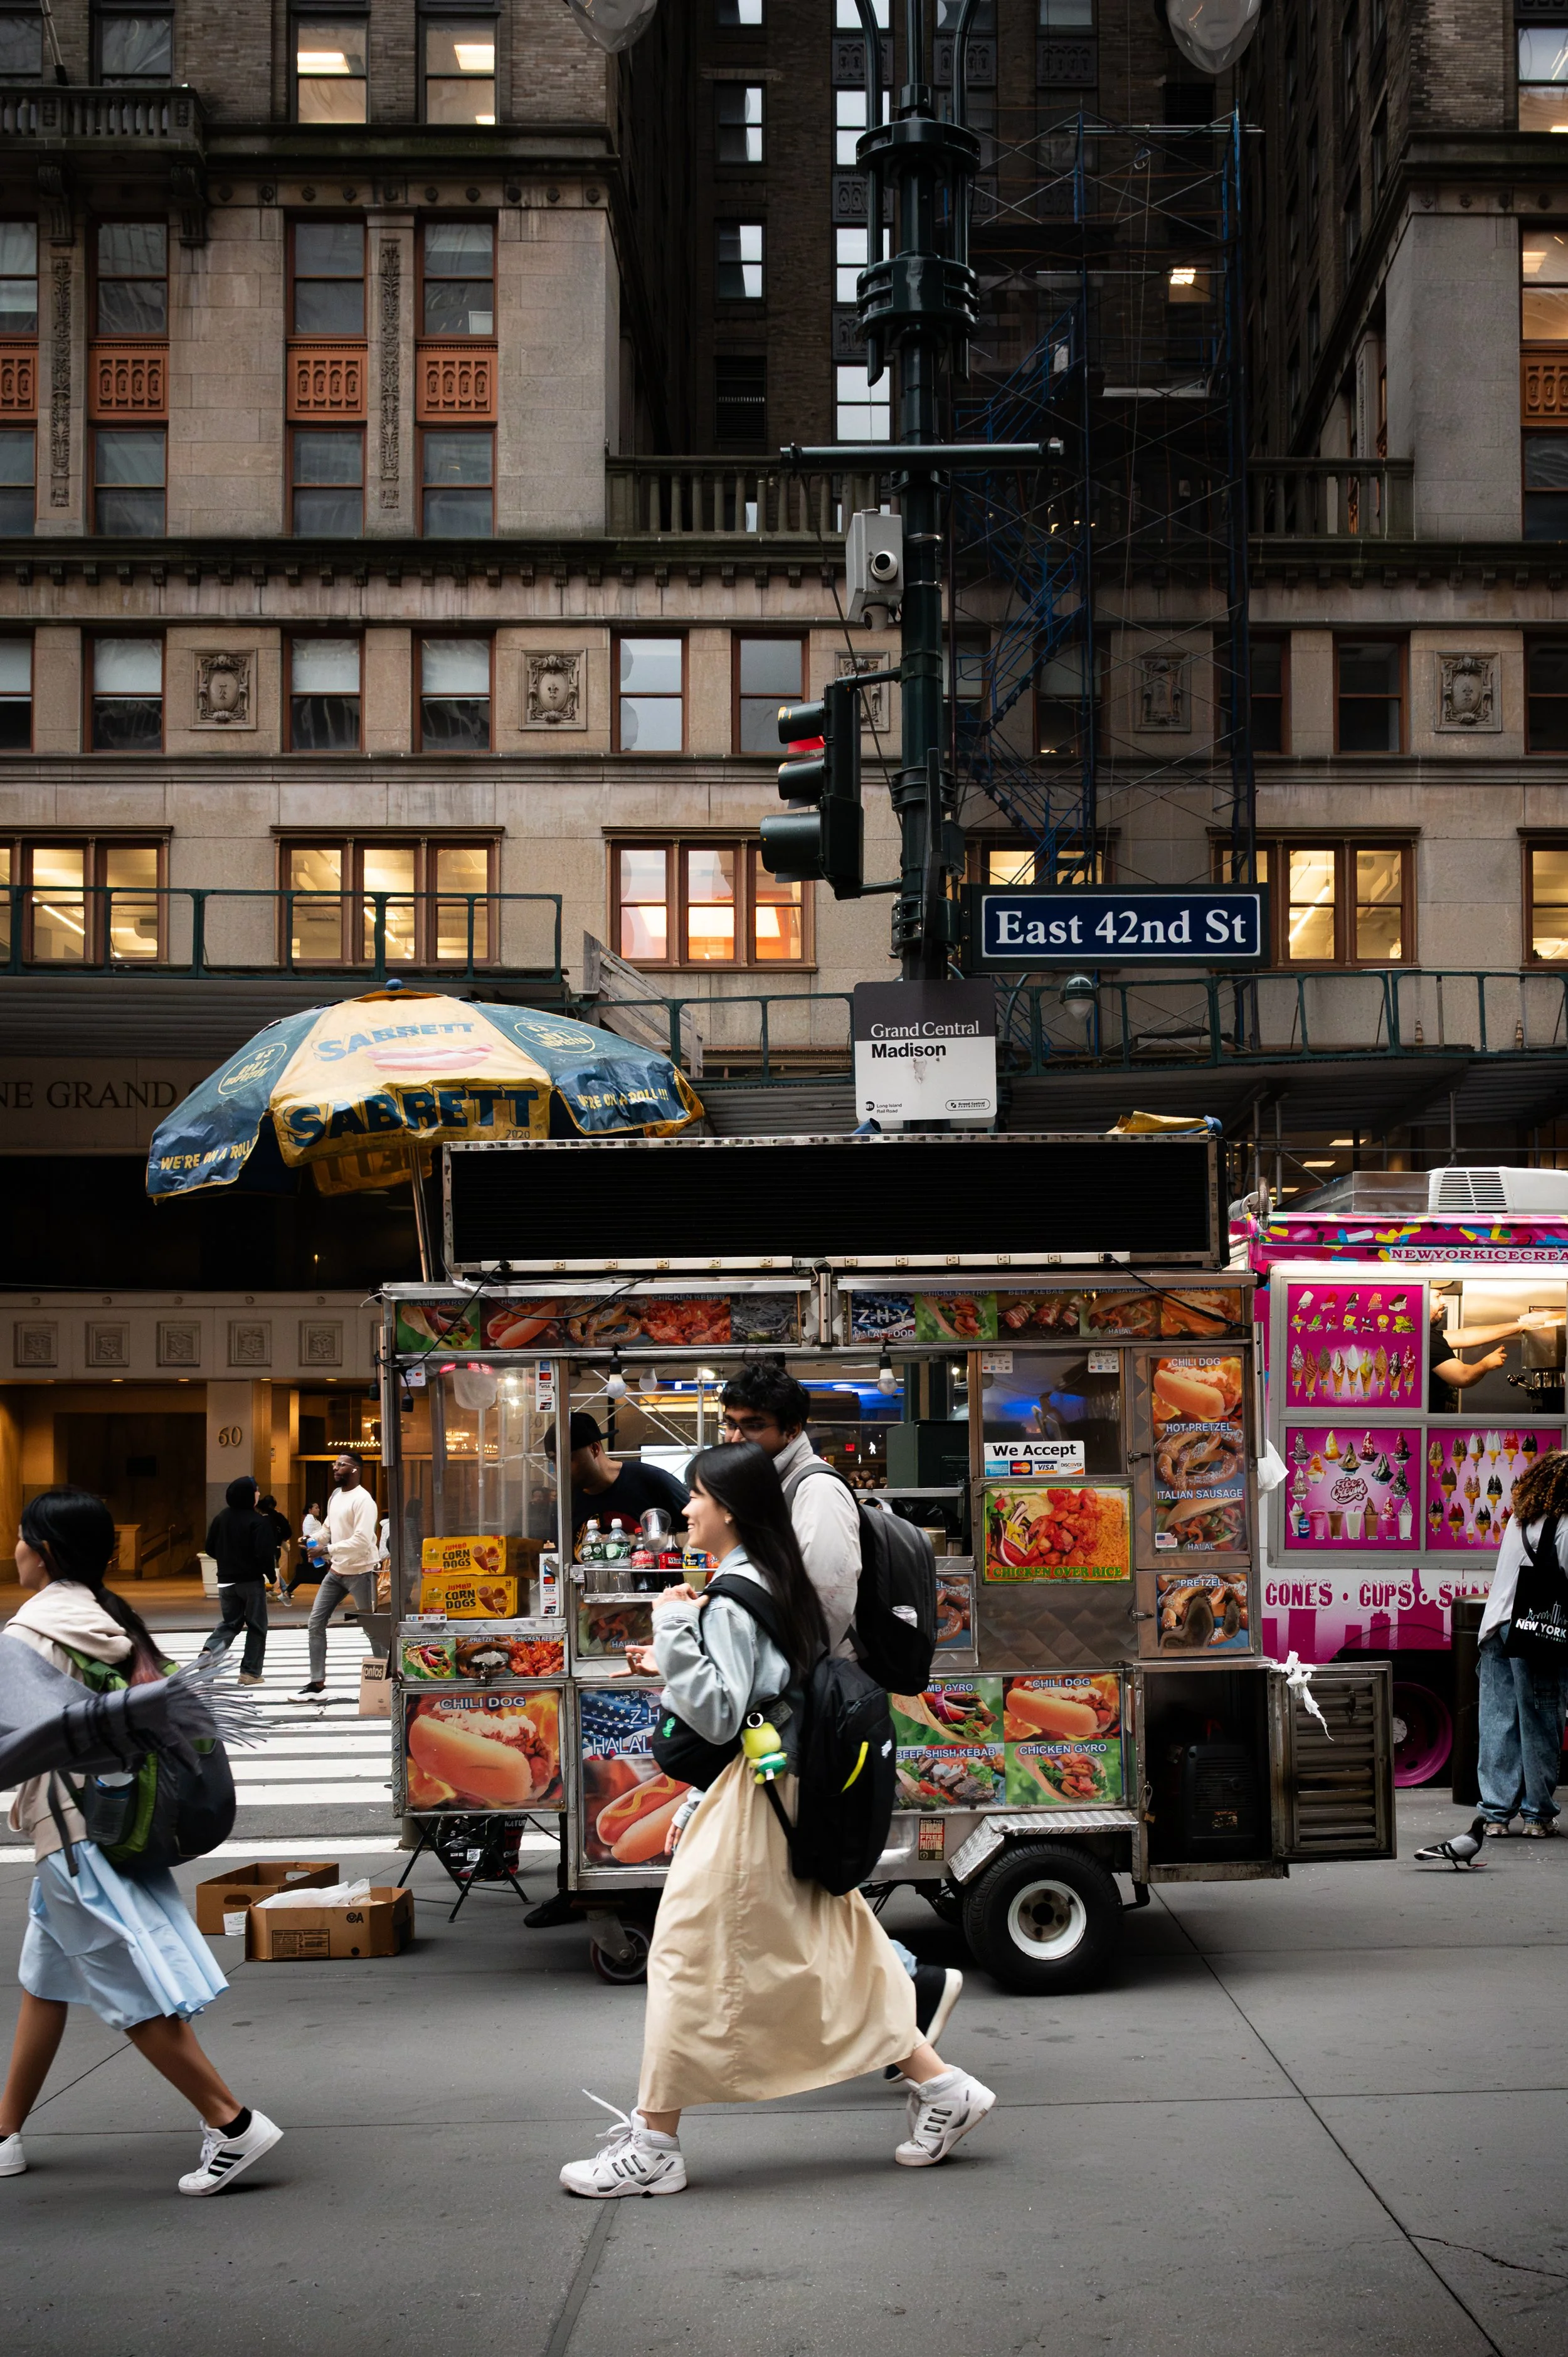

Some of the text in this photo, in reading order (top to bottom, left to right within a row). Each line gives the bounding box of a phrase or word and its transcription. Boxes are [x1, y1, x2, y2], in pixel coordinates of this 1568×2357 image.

[996, 909, 1247, 944] East 42nd St
[871, 1020, 980, 1038] Grand Central
[312, 1021, 474, 1061] SABRETT
[871, 1042, 946, 1059] Madison
[46, 1081, 177, 1109] GRAND
[618, 1093, 628, 1106] A
[628, 1088, 659, 1103] ROLL
[283, 1085, 539, 1147] SABRETT
[506, 1130, 530, 1139] 2020
[161, 1153, 201, 1170] WE'RE
[203, 1149, 219, 1164] ON
[218, 1147, 228, 1161] A
[230, 1140, 251, 1159] ROLL
[853, 1329, 914, 1339] HALAL FOOD
[1172, 1357, 1221, 1366] CHILI DOG
[1166, 1422, 1232, 1432] HOT PRETZEL
[218, 1426, 243, 1447] 60
[993, 1444, 1076, 1457] We Accept
[1157, 1489, 1243, 1499] ITALIAN SAUSAGE
[445, 1543, 467, 1551] JUMBO
[443, 1549, 470, 1560] CORN
[443, 1558, 470, 1569] DOGS
[993, 1567, 1121, 1577] CHICKEN OVER RICE
[445, 1590, 475, 1600] CORN
[1266, 1580, 1333, 1607] CONES
[1359, 1580, 1413, 1608] CUPS
[446, 1599, 476, 1610] DOGS
[1515, 1619, 1566, 1638] NEW YORK
[945, 1683, 973, 1692] GYRO
[1032, 1678, 1090, 1688] CHILI DOG
[441, 1696, 526, 1709] CHILI DOG
[593, 1735, 652, 1754] HALAL
[1019, 1743, 1106, 1755] CHICKEN GYRO
[896, 1748, 995, 1758] BEEF SHISH KEBAB
[919, 1840, 943, 1849] PALESTINE
